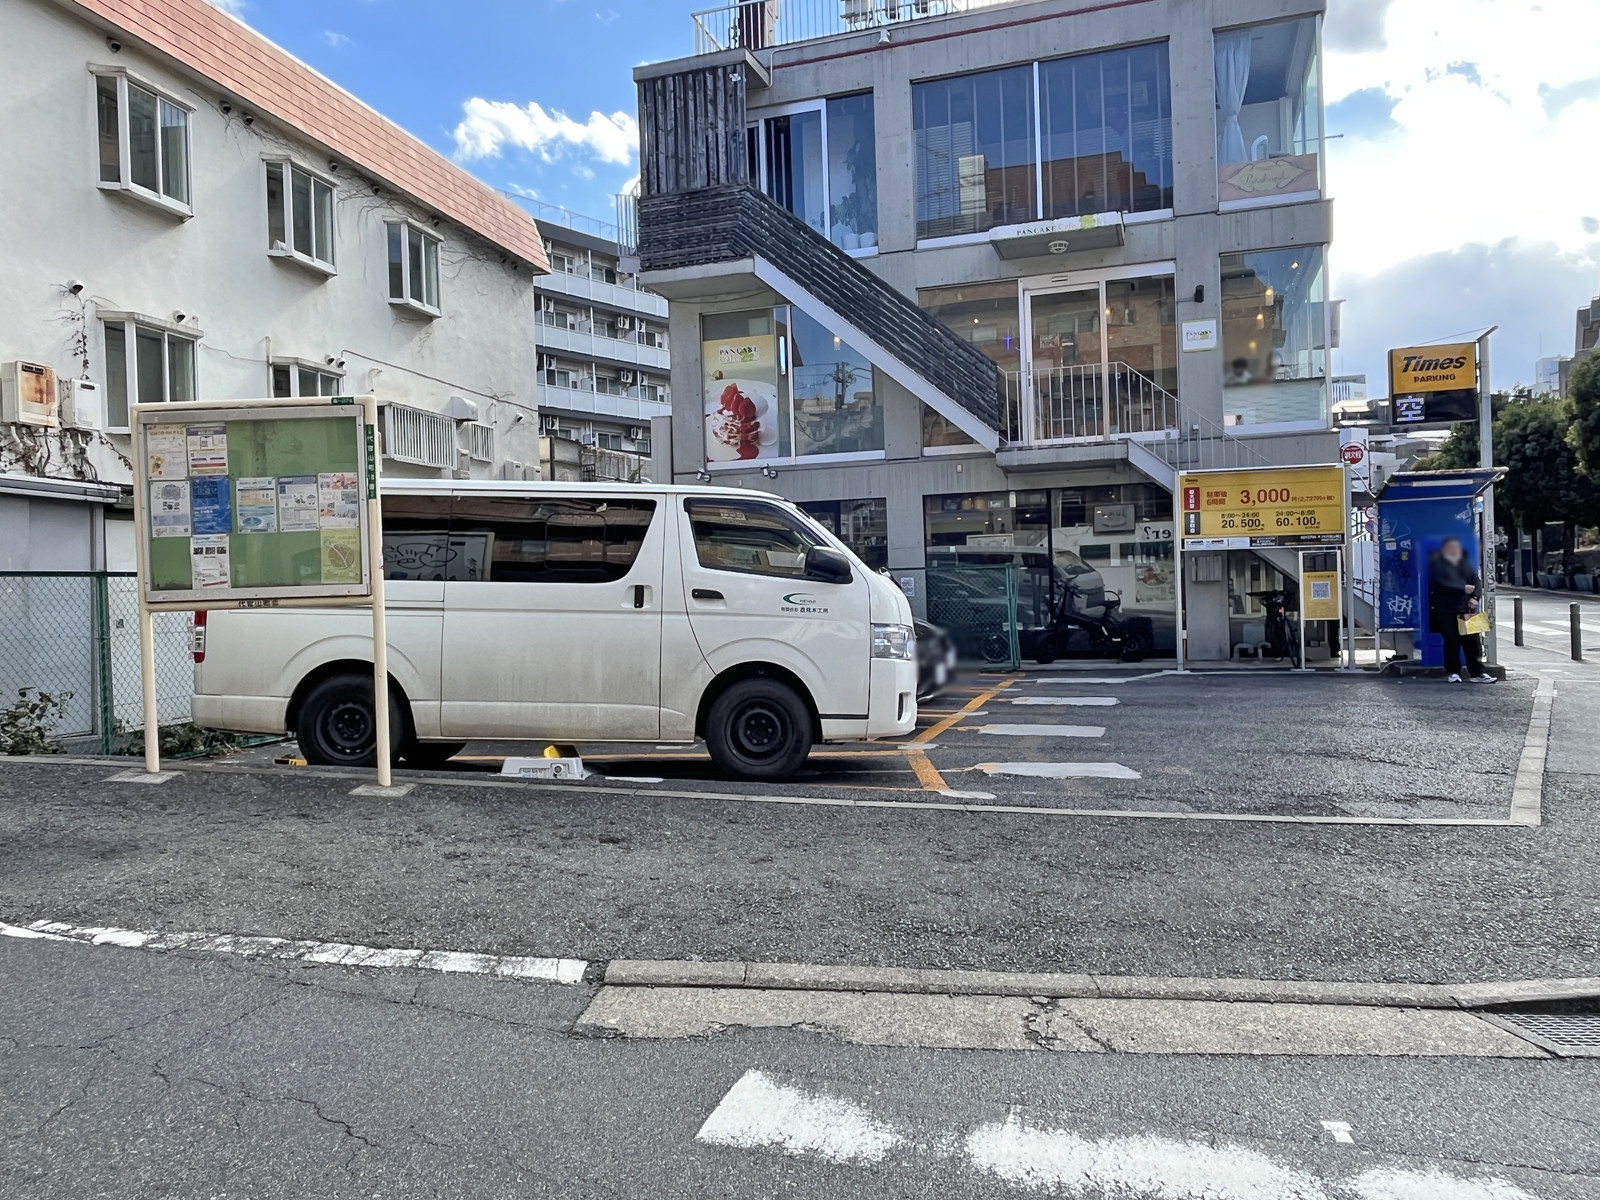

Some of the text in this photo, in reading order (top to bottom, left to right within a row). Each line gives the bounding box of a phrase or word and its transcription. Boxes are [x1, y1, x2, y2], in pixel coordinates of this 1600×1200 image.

[1016, 225, 1056, 236] PANCAKE
[1402, 355, 1467, 373] Times
[1413, 374, 1456, 383] PARKING
[1396, 396, 1425, 422] 空
[1240, 488, 1290, 506] 3,000
